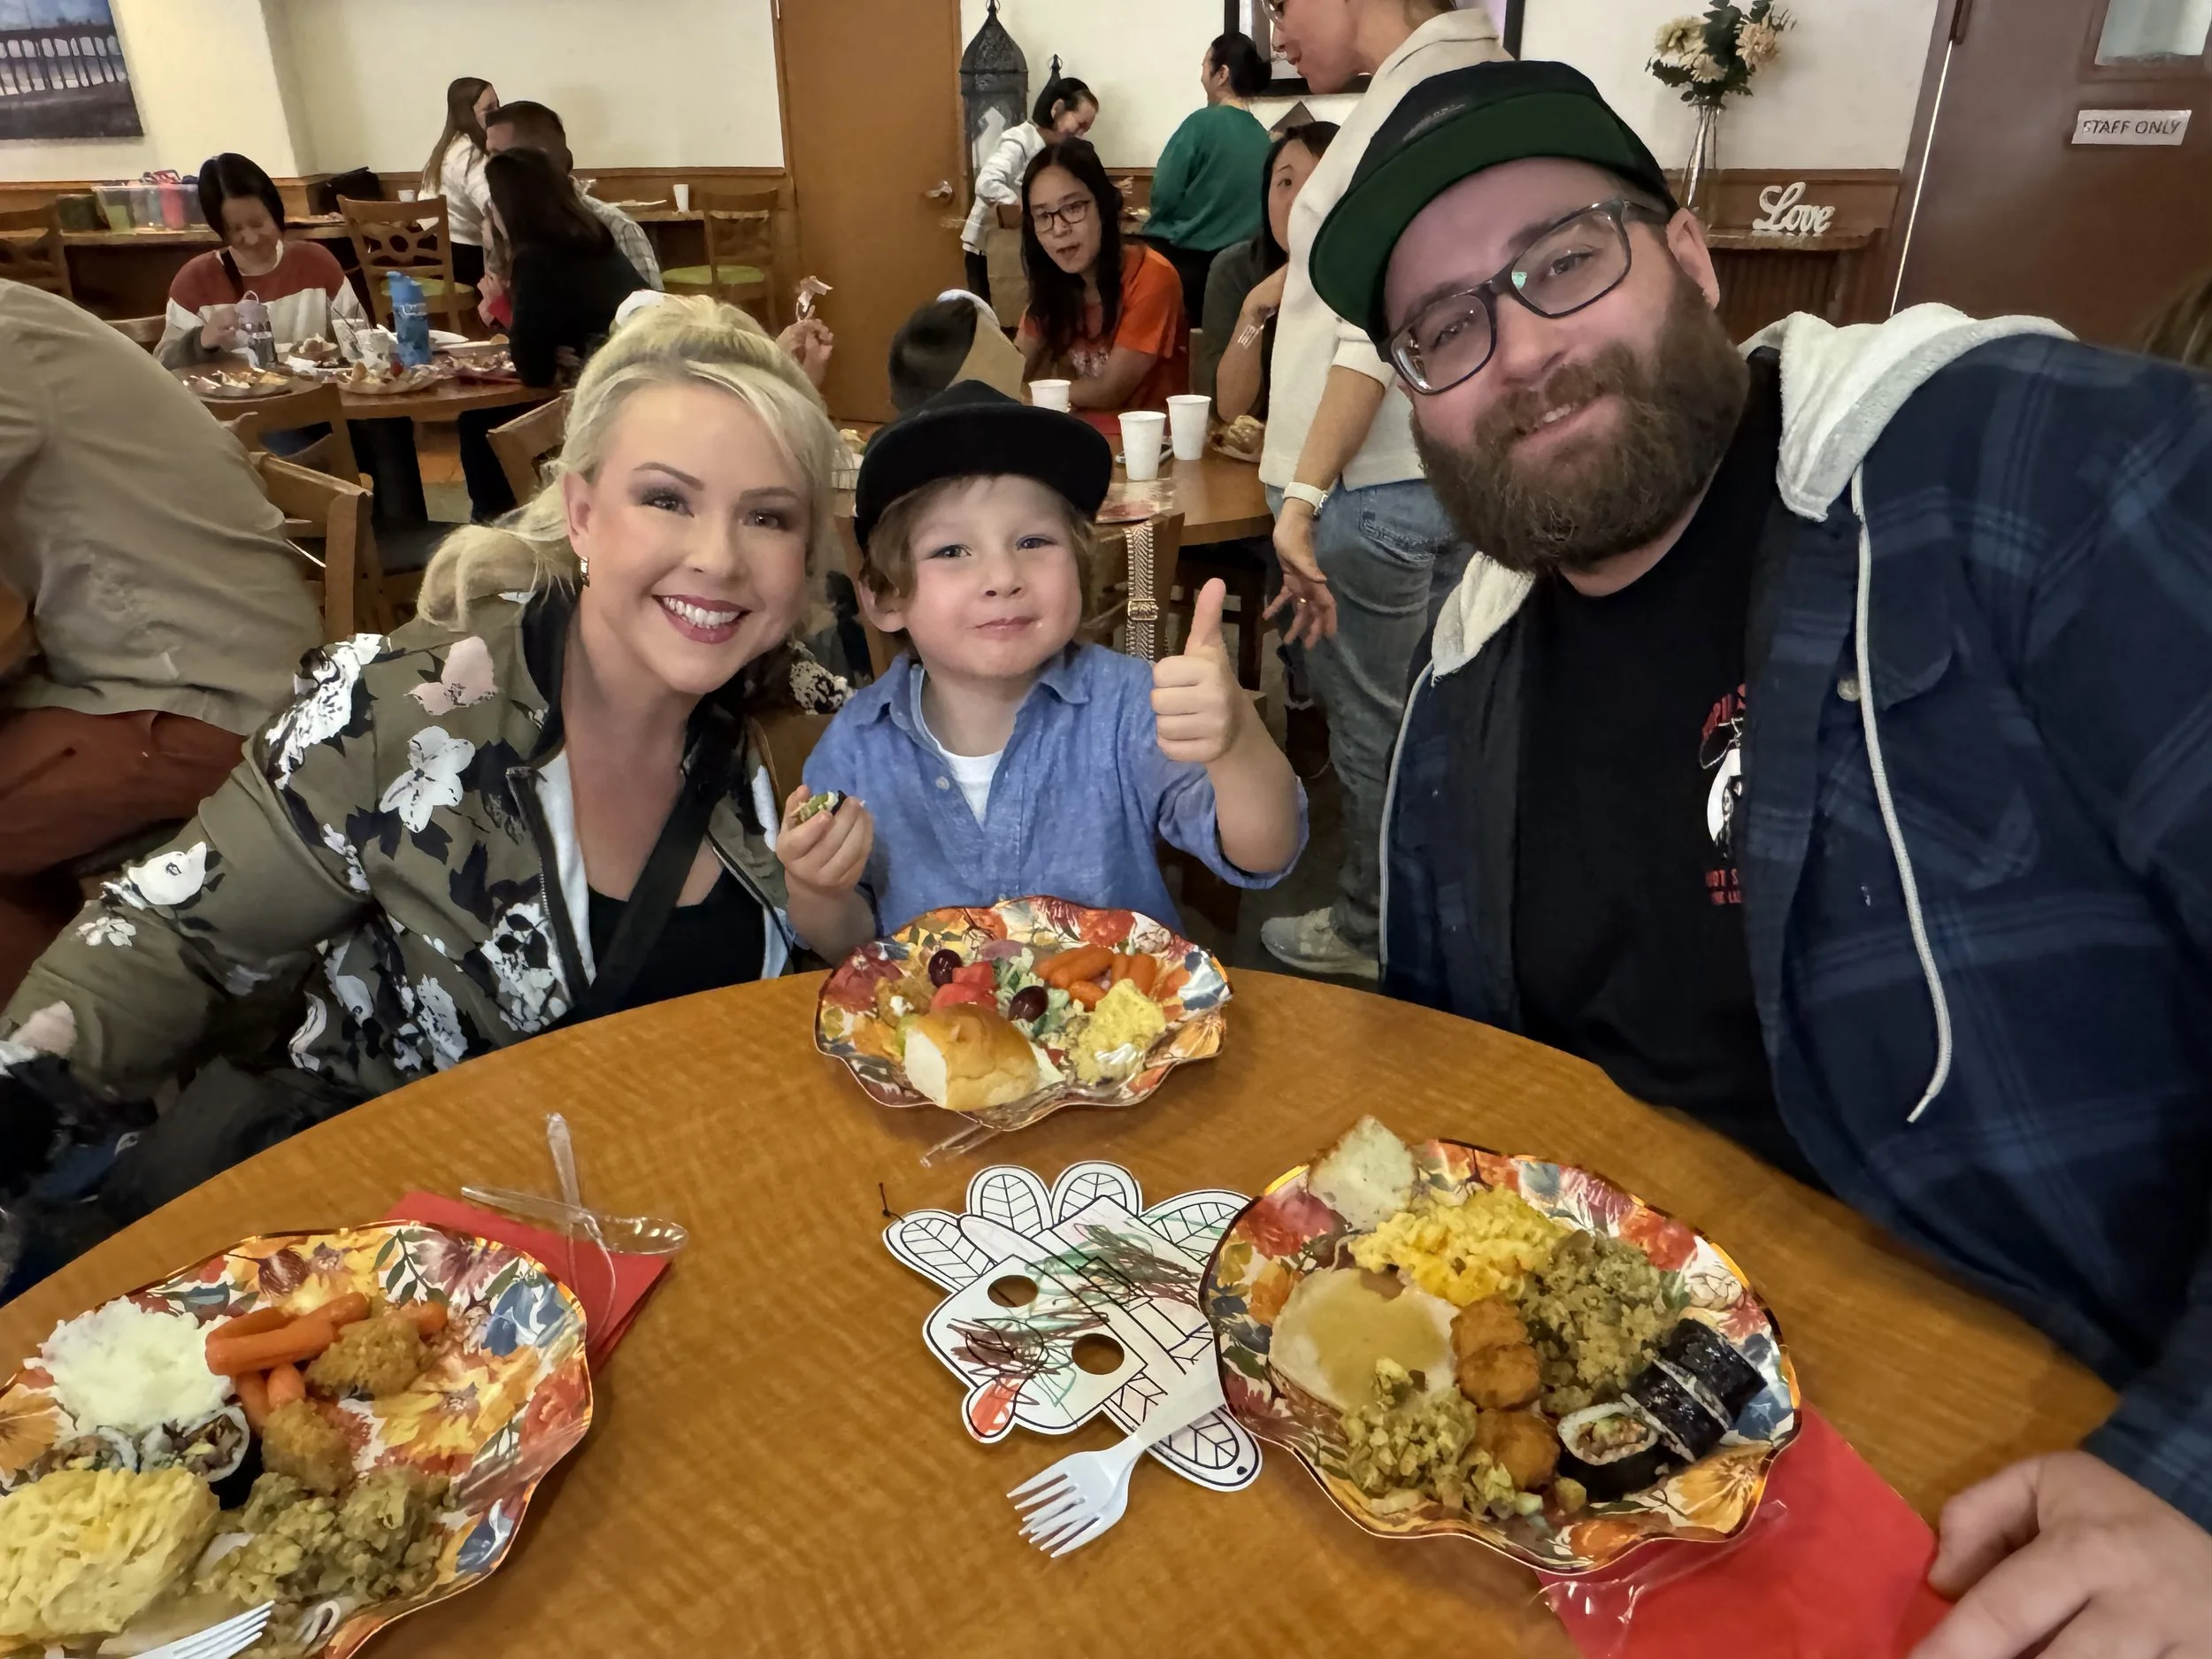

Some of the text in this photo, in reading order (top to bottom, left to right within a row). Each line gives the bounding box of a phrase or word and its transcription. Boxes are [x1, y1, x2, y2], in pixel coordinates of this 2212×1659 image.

[2082, 119, 2182, 134] STAFF ONLY
[1752, 181, 1835, 234] Love
